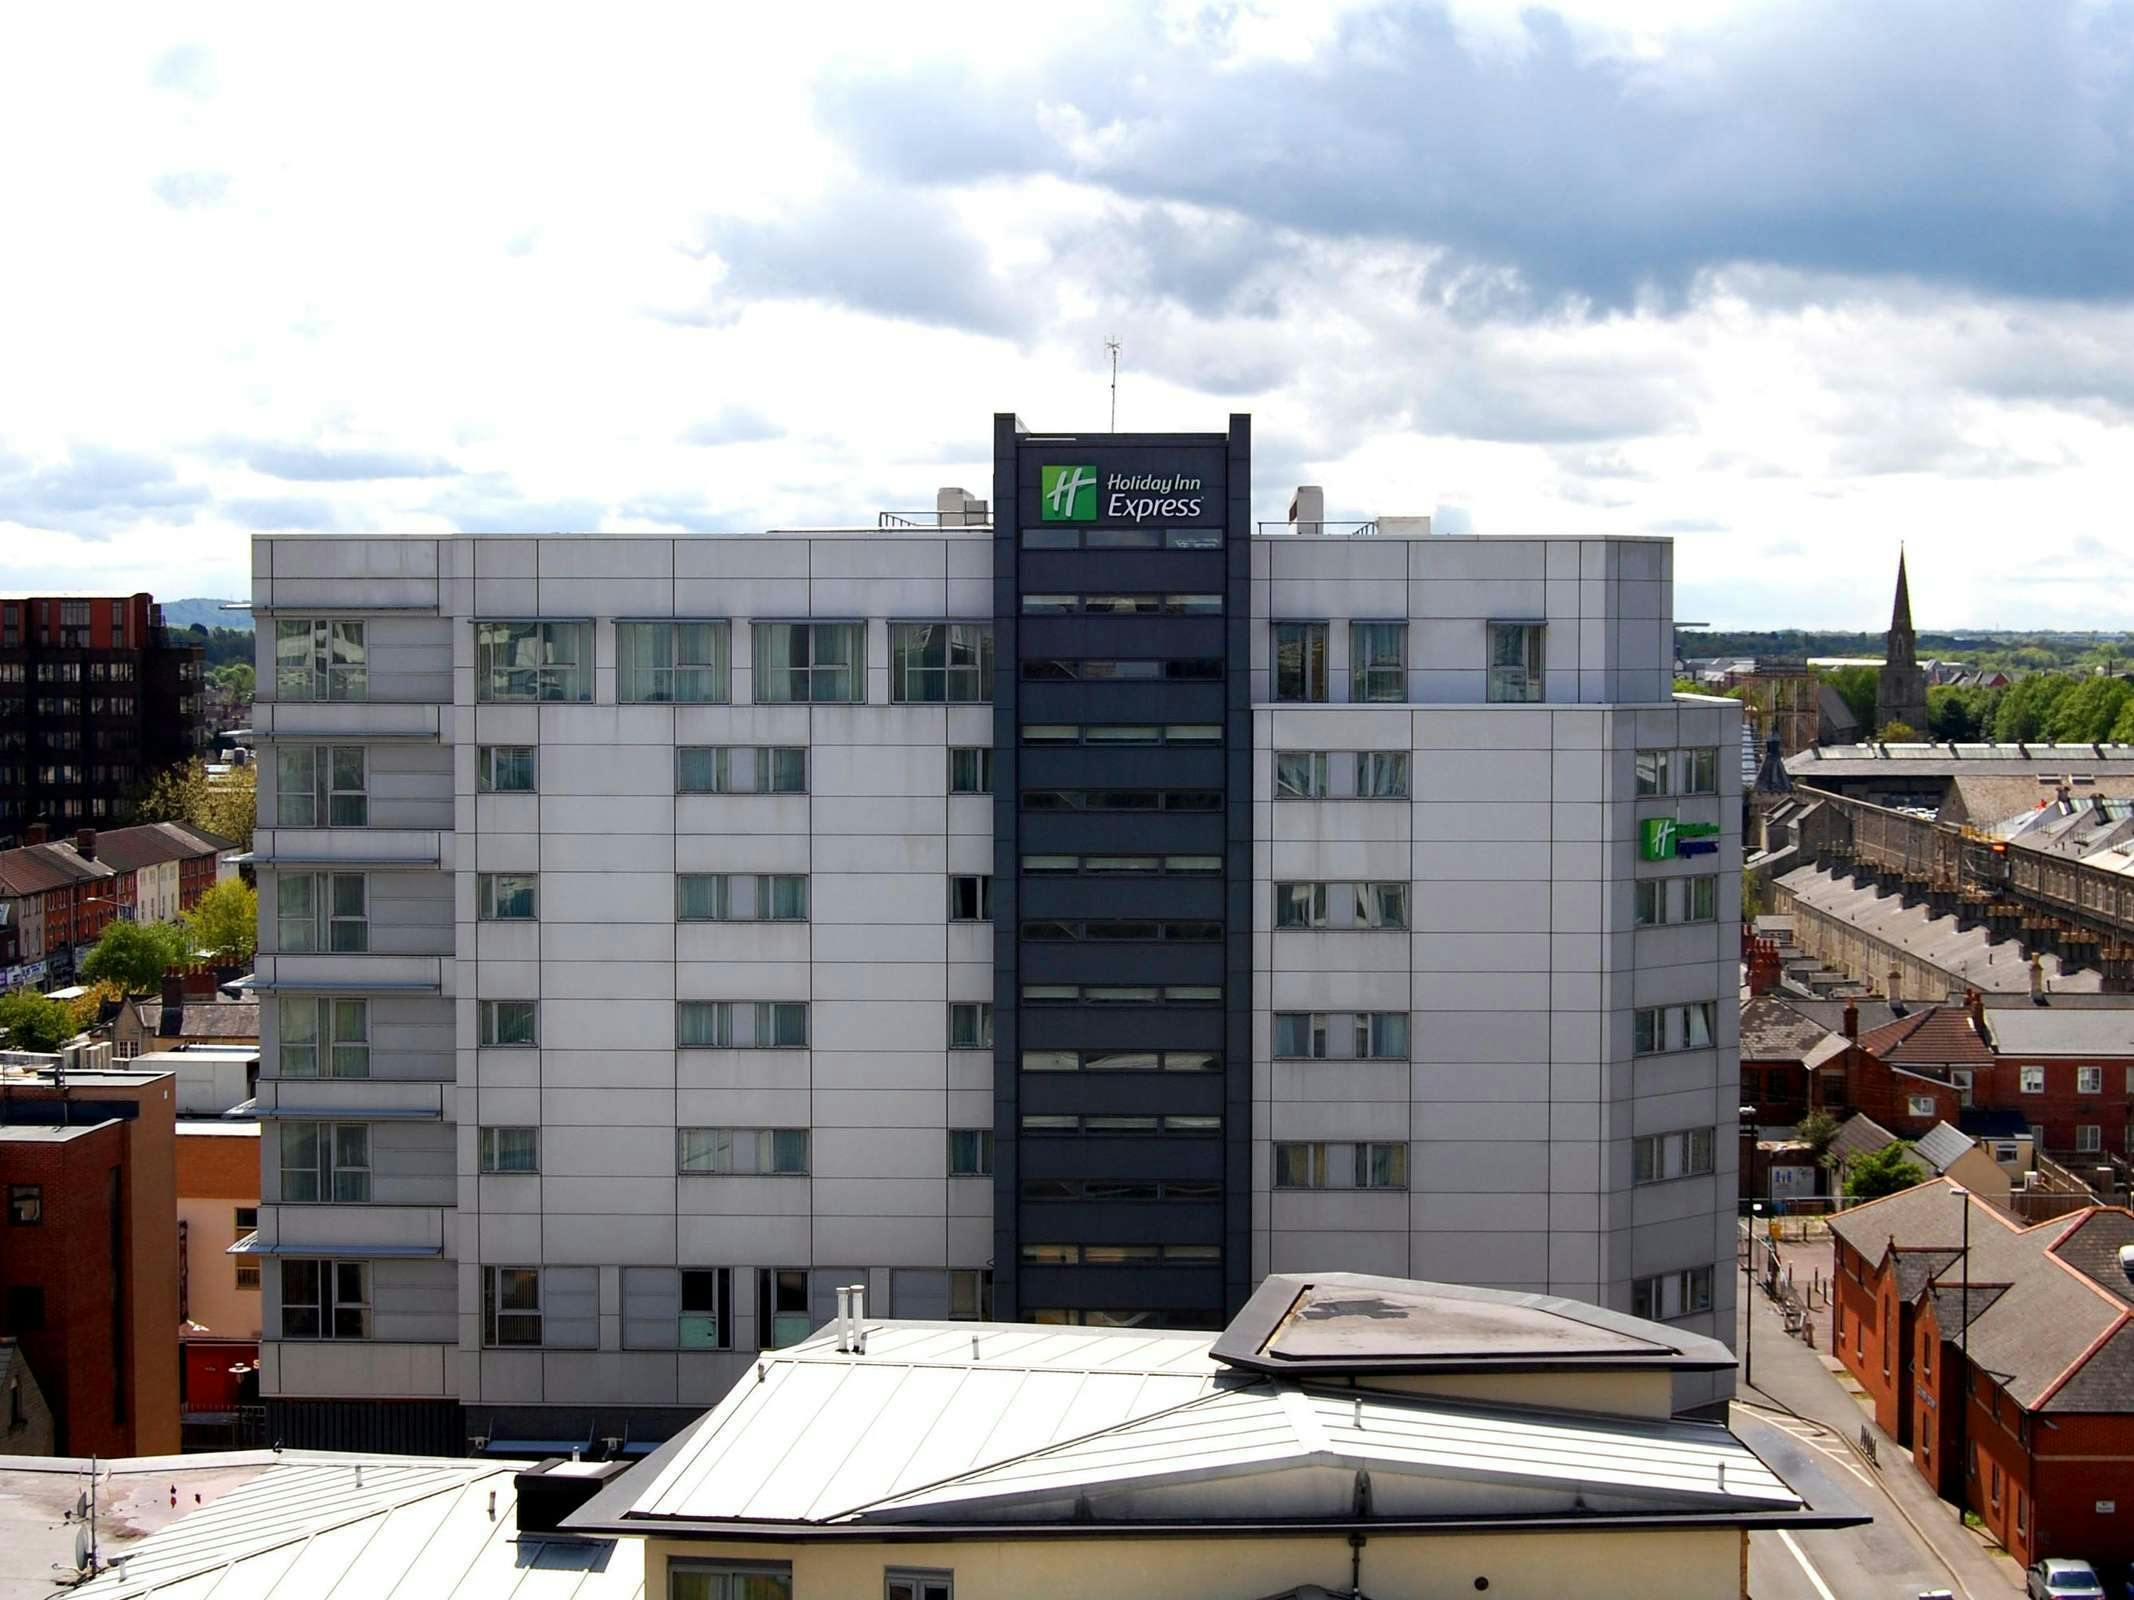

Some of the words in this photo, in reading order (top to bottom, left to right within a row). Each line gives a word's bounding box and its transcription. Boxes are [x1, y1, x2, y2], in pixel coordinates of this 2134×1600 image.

[1107, 473, 1174, 494] Holiday
[1175, 474, 1201, 491] Inn
[1108, 493, 1202, 522] Express
